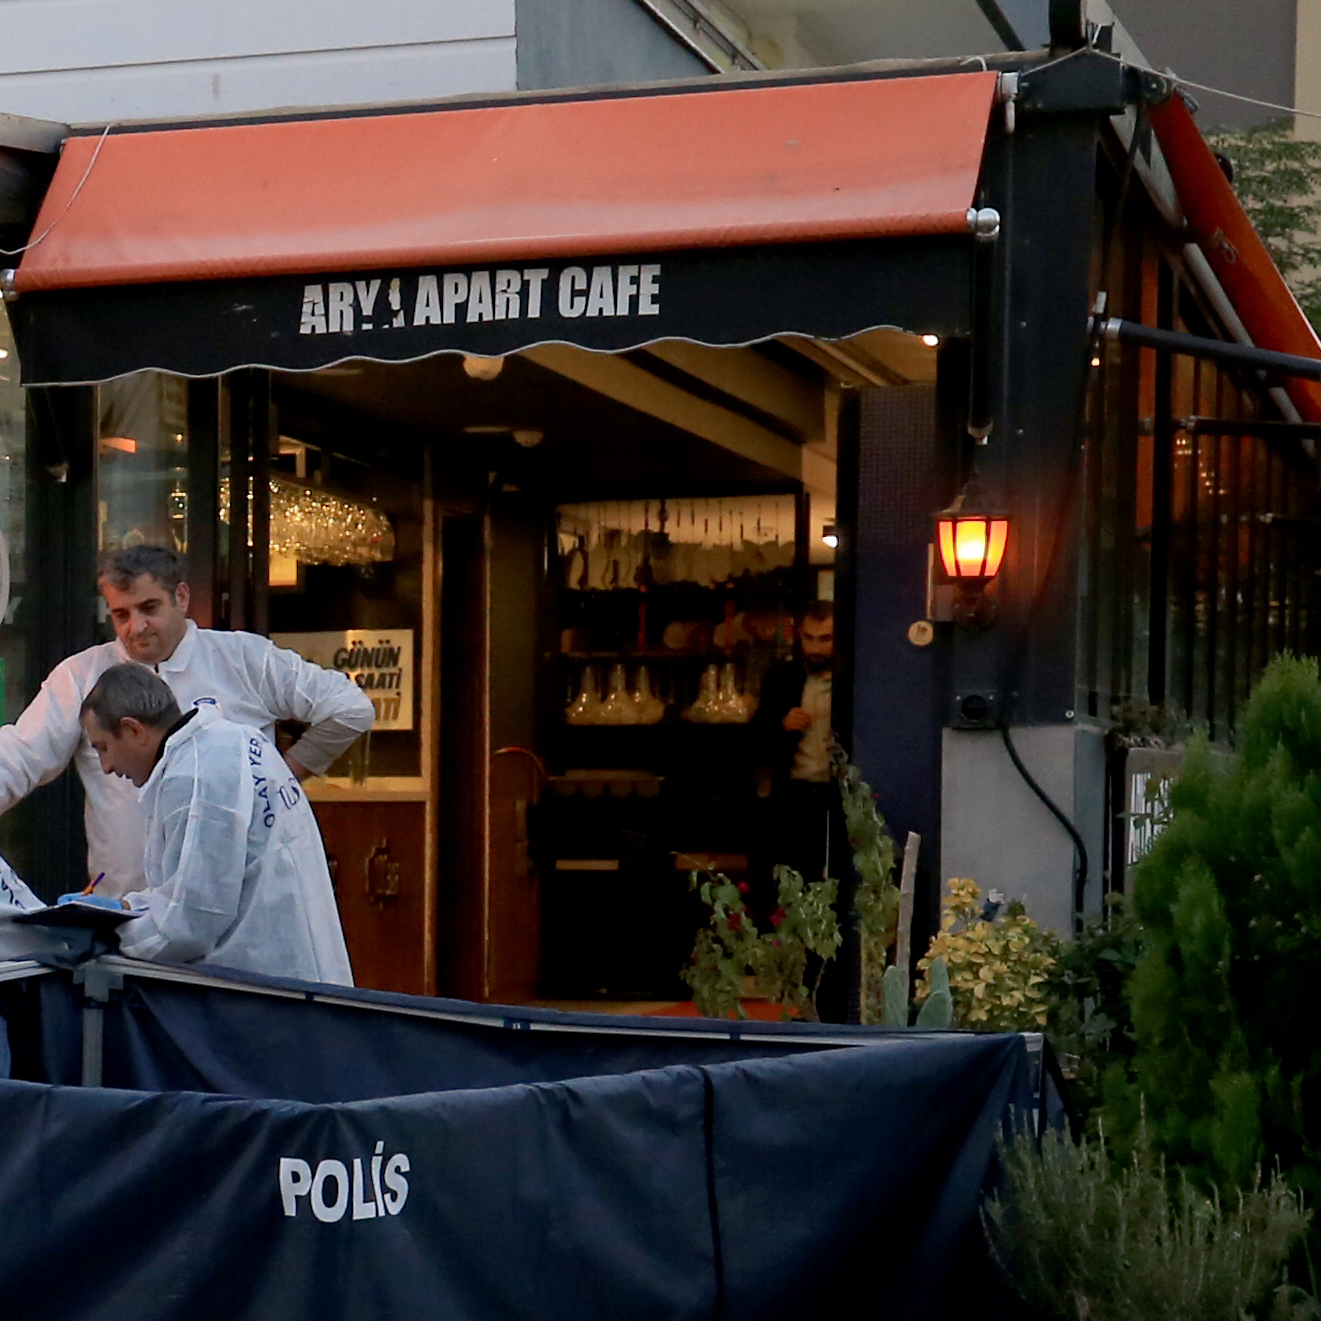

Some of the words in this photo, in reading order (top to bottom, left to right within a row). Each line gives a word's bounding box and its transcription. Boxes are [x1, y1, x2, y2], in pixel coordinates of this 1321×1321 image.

[413, 268, 549, 326] APART
[558, 264, 661, 318] CAFE
[334, 640, 402, 671] GÜNÜN
[252, 774, 276, 829] OLAY
[279, 1140, 410, 1223] POLİS
